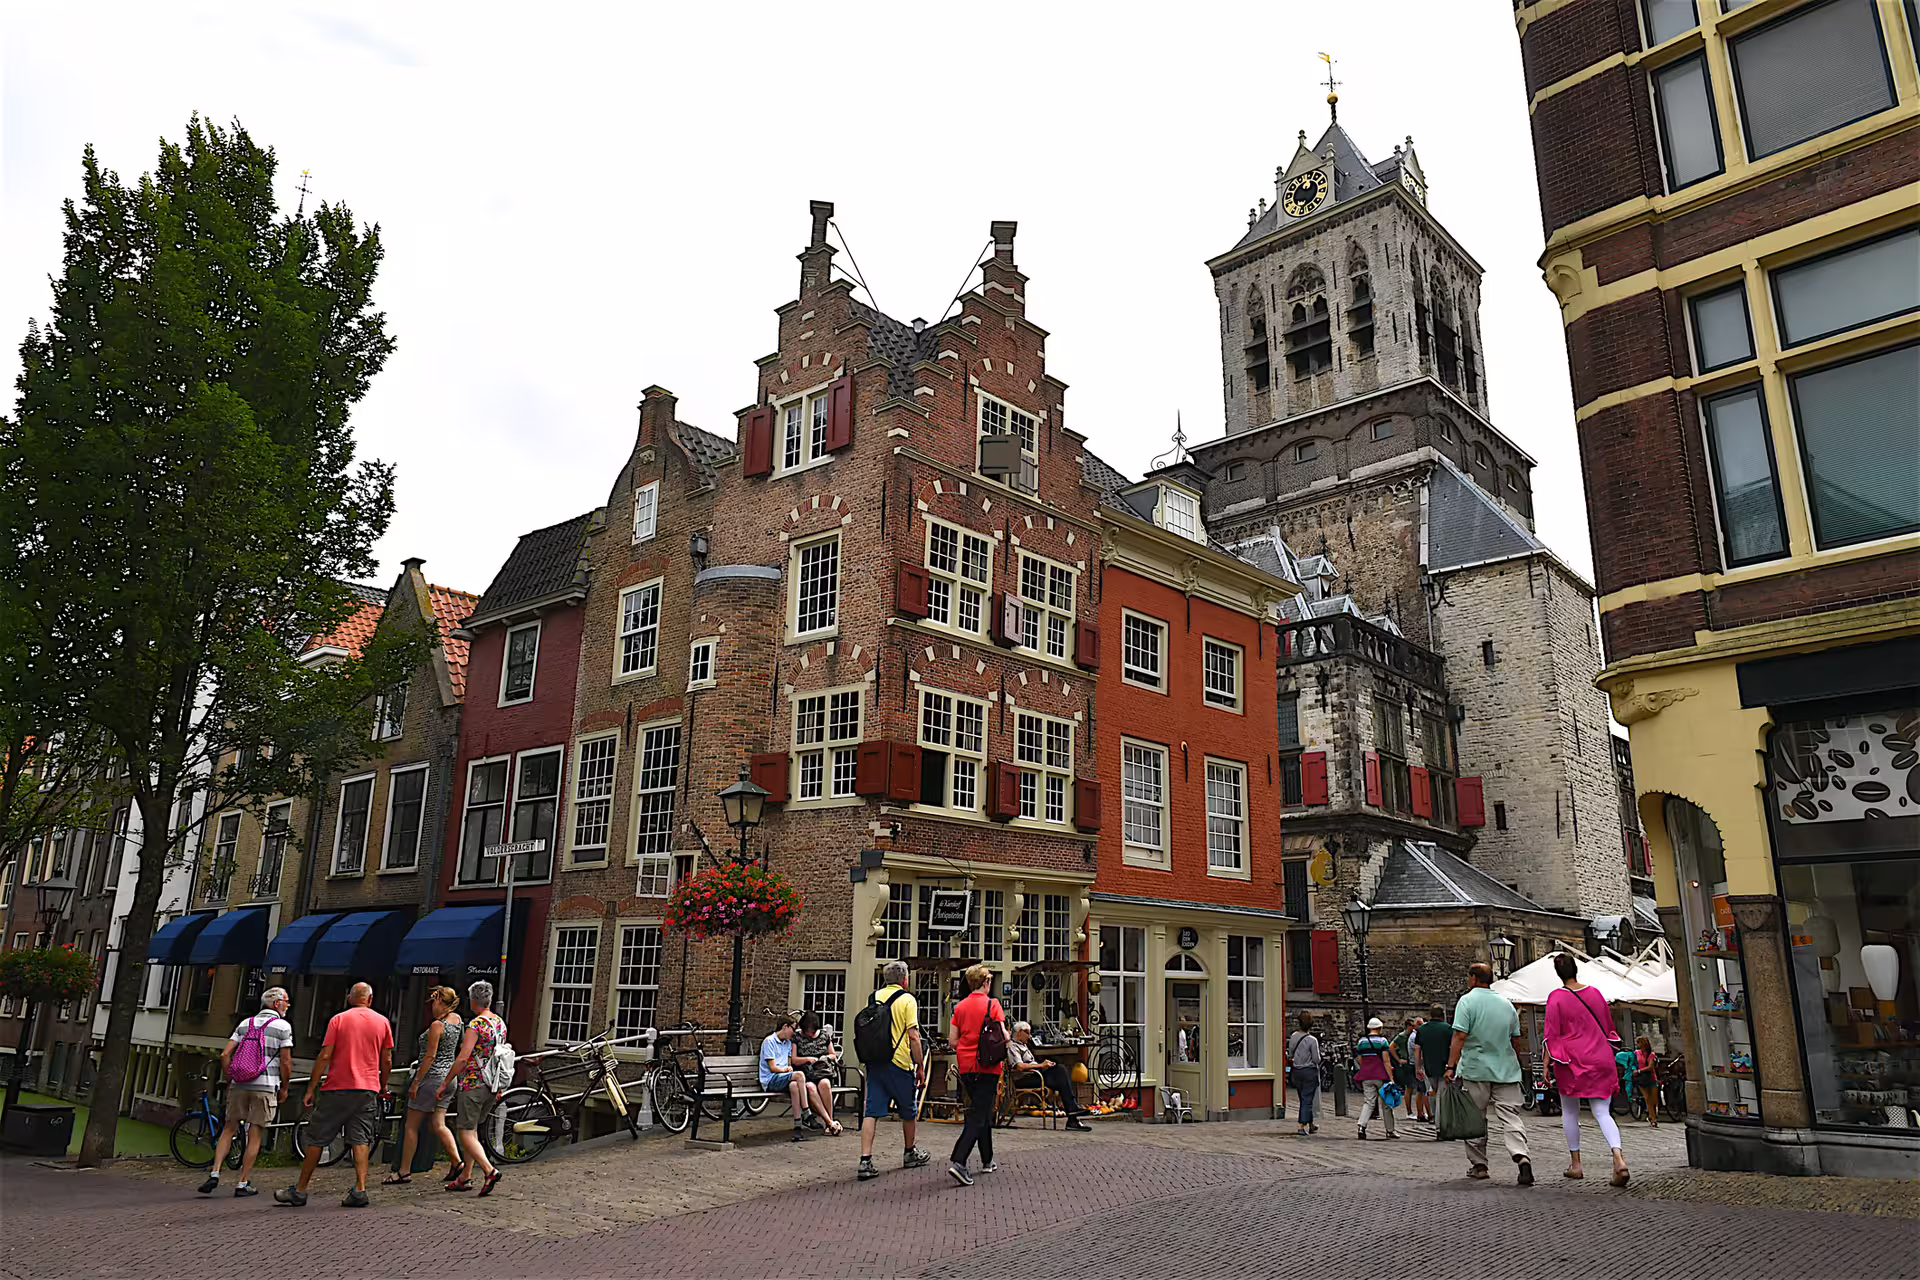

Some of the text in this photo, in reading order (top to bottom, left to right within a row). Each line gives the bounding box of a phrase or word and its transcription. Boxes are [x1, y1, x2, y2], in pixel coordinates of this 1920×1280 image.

[486, 842, 535, 855] VOLDERSGRACHT
[412, 966, 440, 974] RISTORANTE
[467, 965, 499, 975] Stromboli
